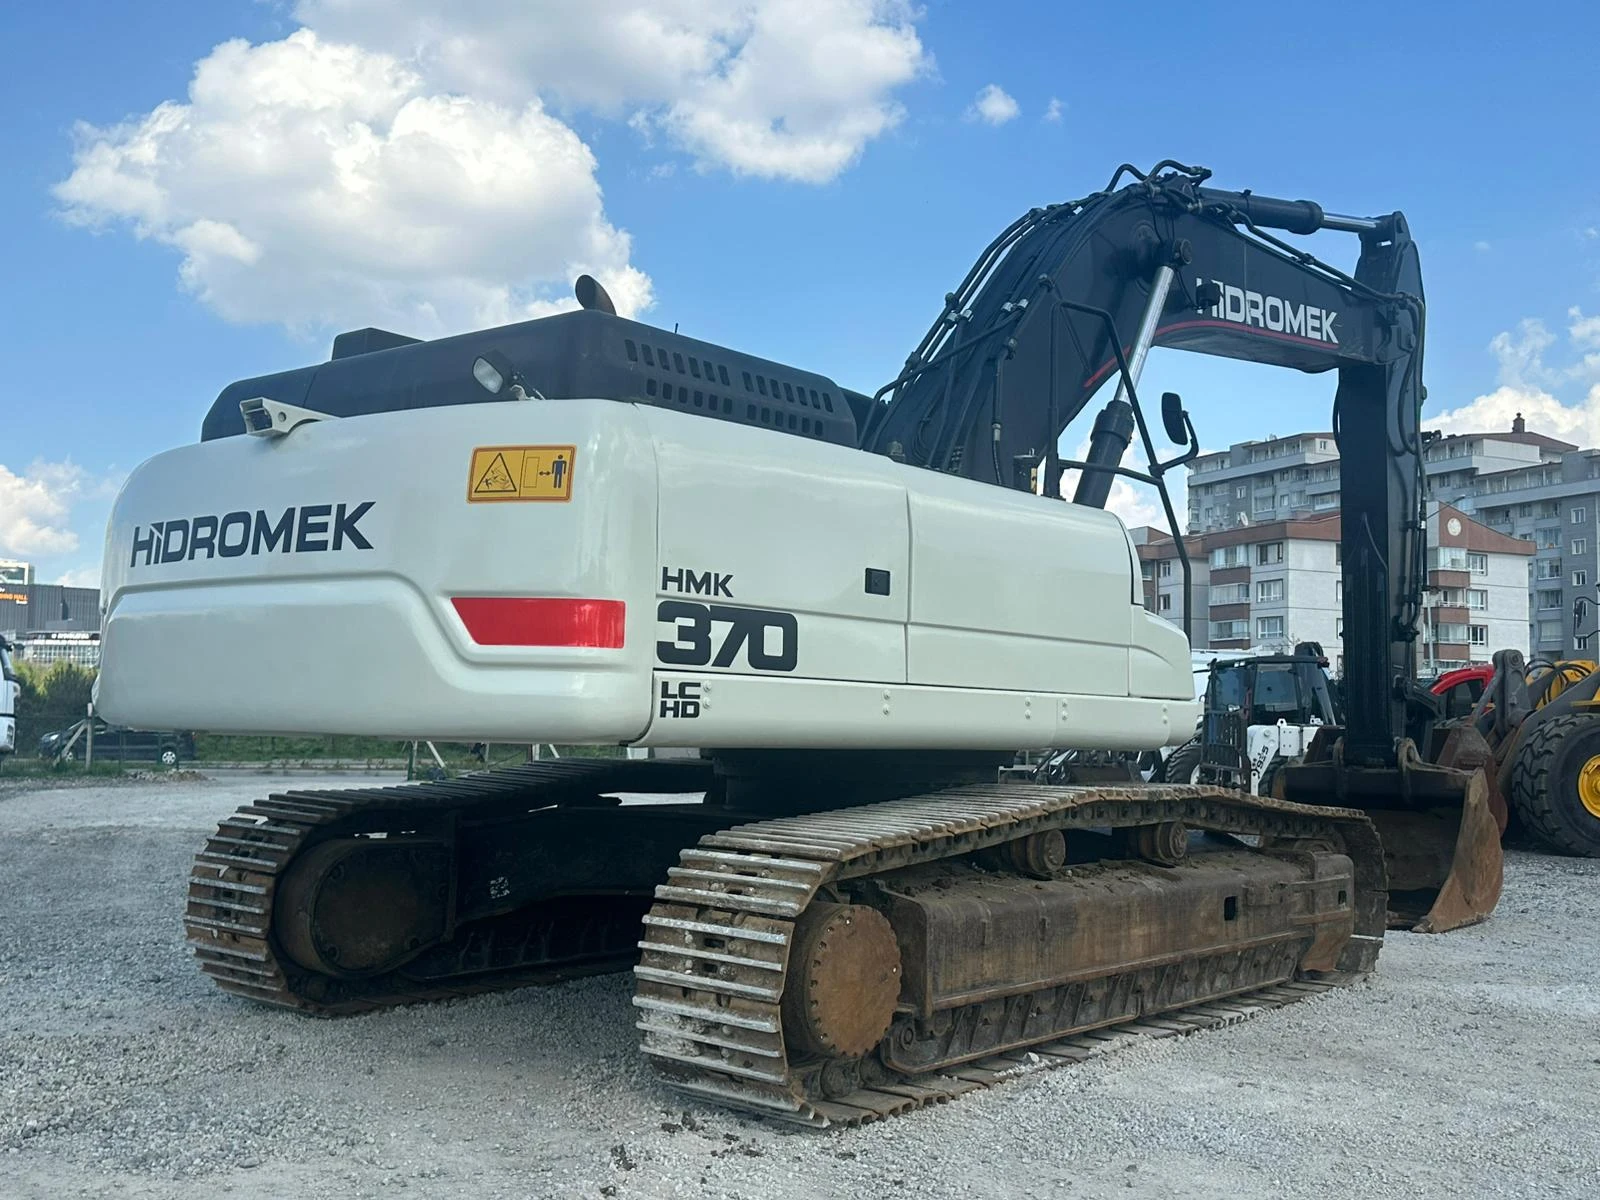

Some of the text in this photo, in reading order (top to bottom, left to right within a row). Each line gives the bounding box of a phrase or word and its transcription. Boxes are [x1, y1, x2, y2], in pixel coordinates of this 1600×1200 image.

[661, 566, 734, 598] HMK
[656, 600, 798, 672] 370
[661, 681, 701, 699] LC
[659, 700, 700, 719] HD
